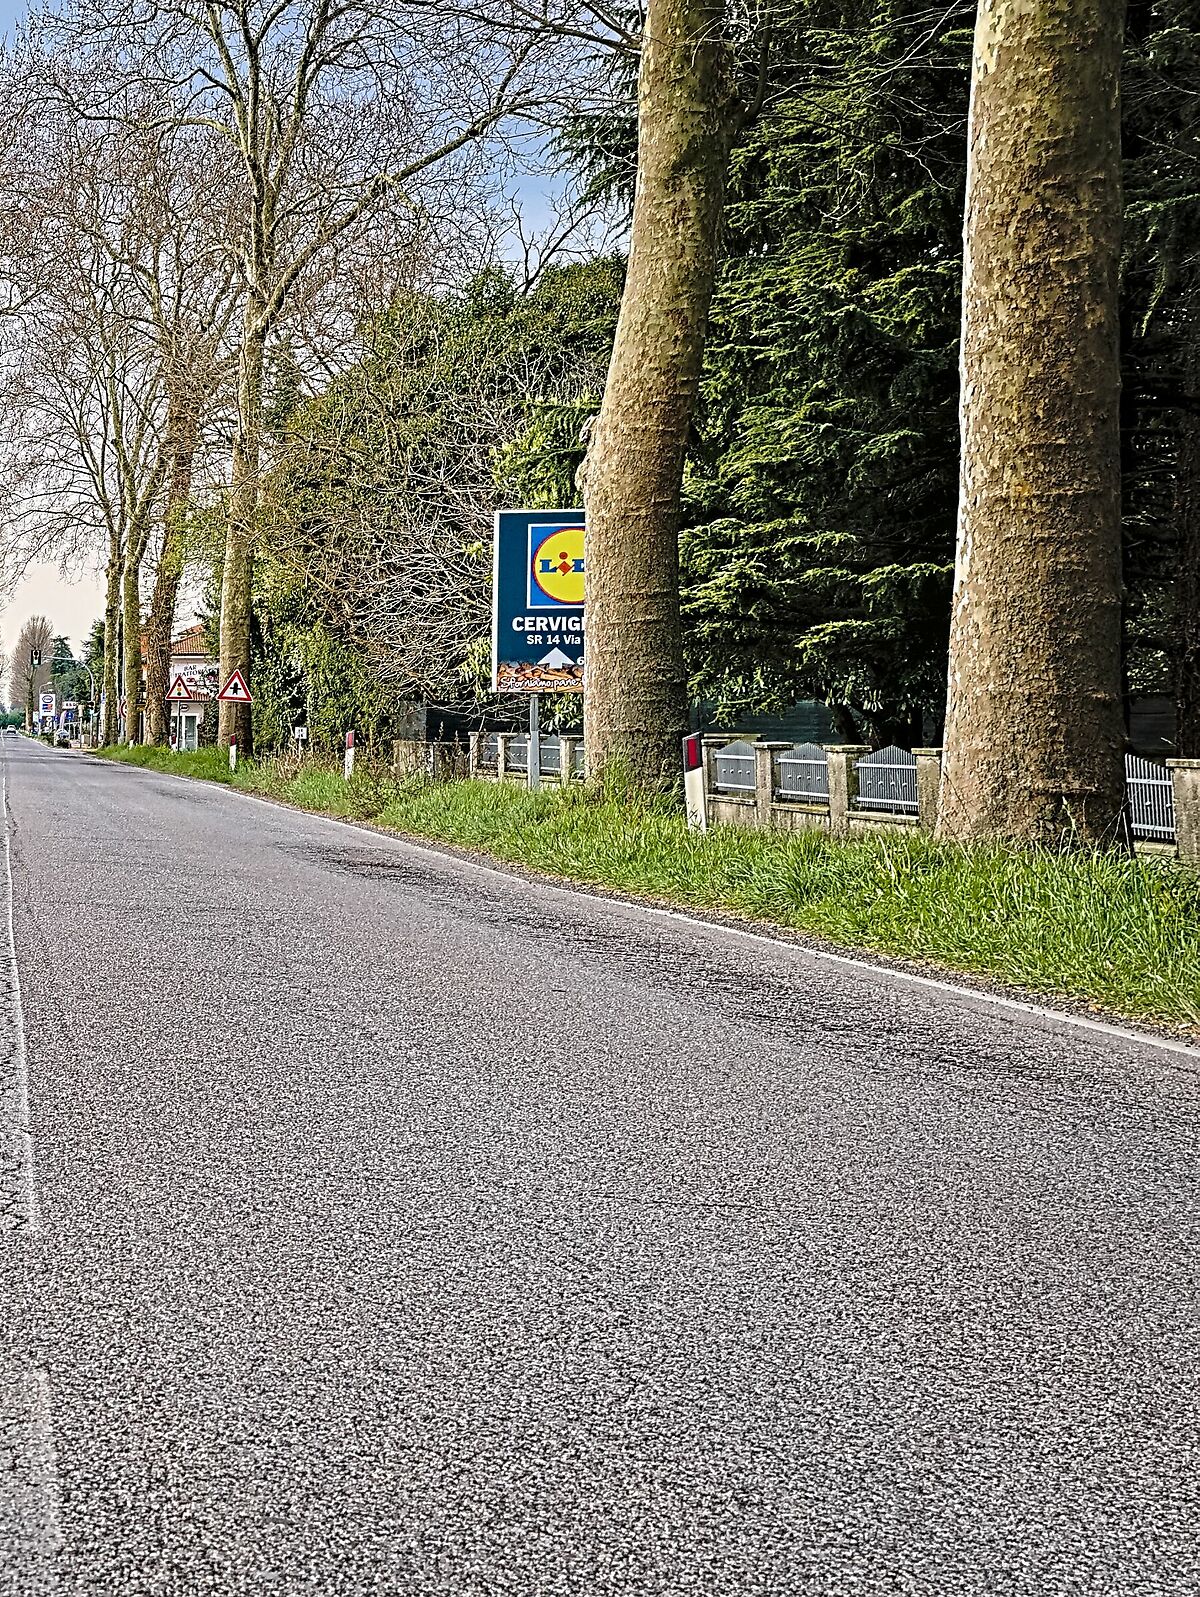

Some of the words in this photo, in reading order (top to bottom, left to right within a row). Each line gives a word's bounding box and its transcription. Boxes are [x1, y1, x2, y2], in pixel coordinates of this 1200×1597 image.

[526, 634, 543, 645] SR
[546, 634, 560, 645] 14
[562, 634, 581, 645] Via
